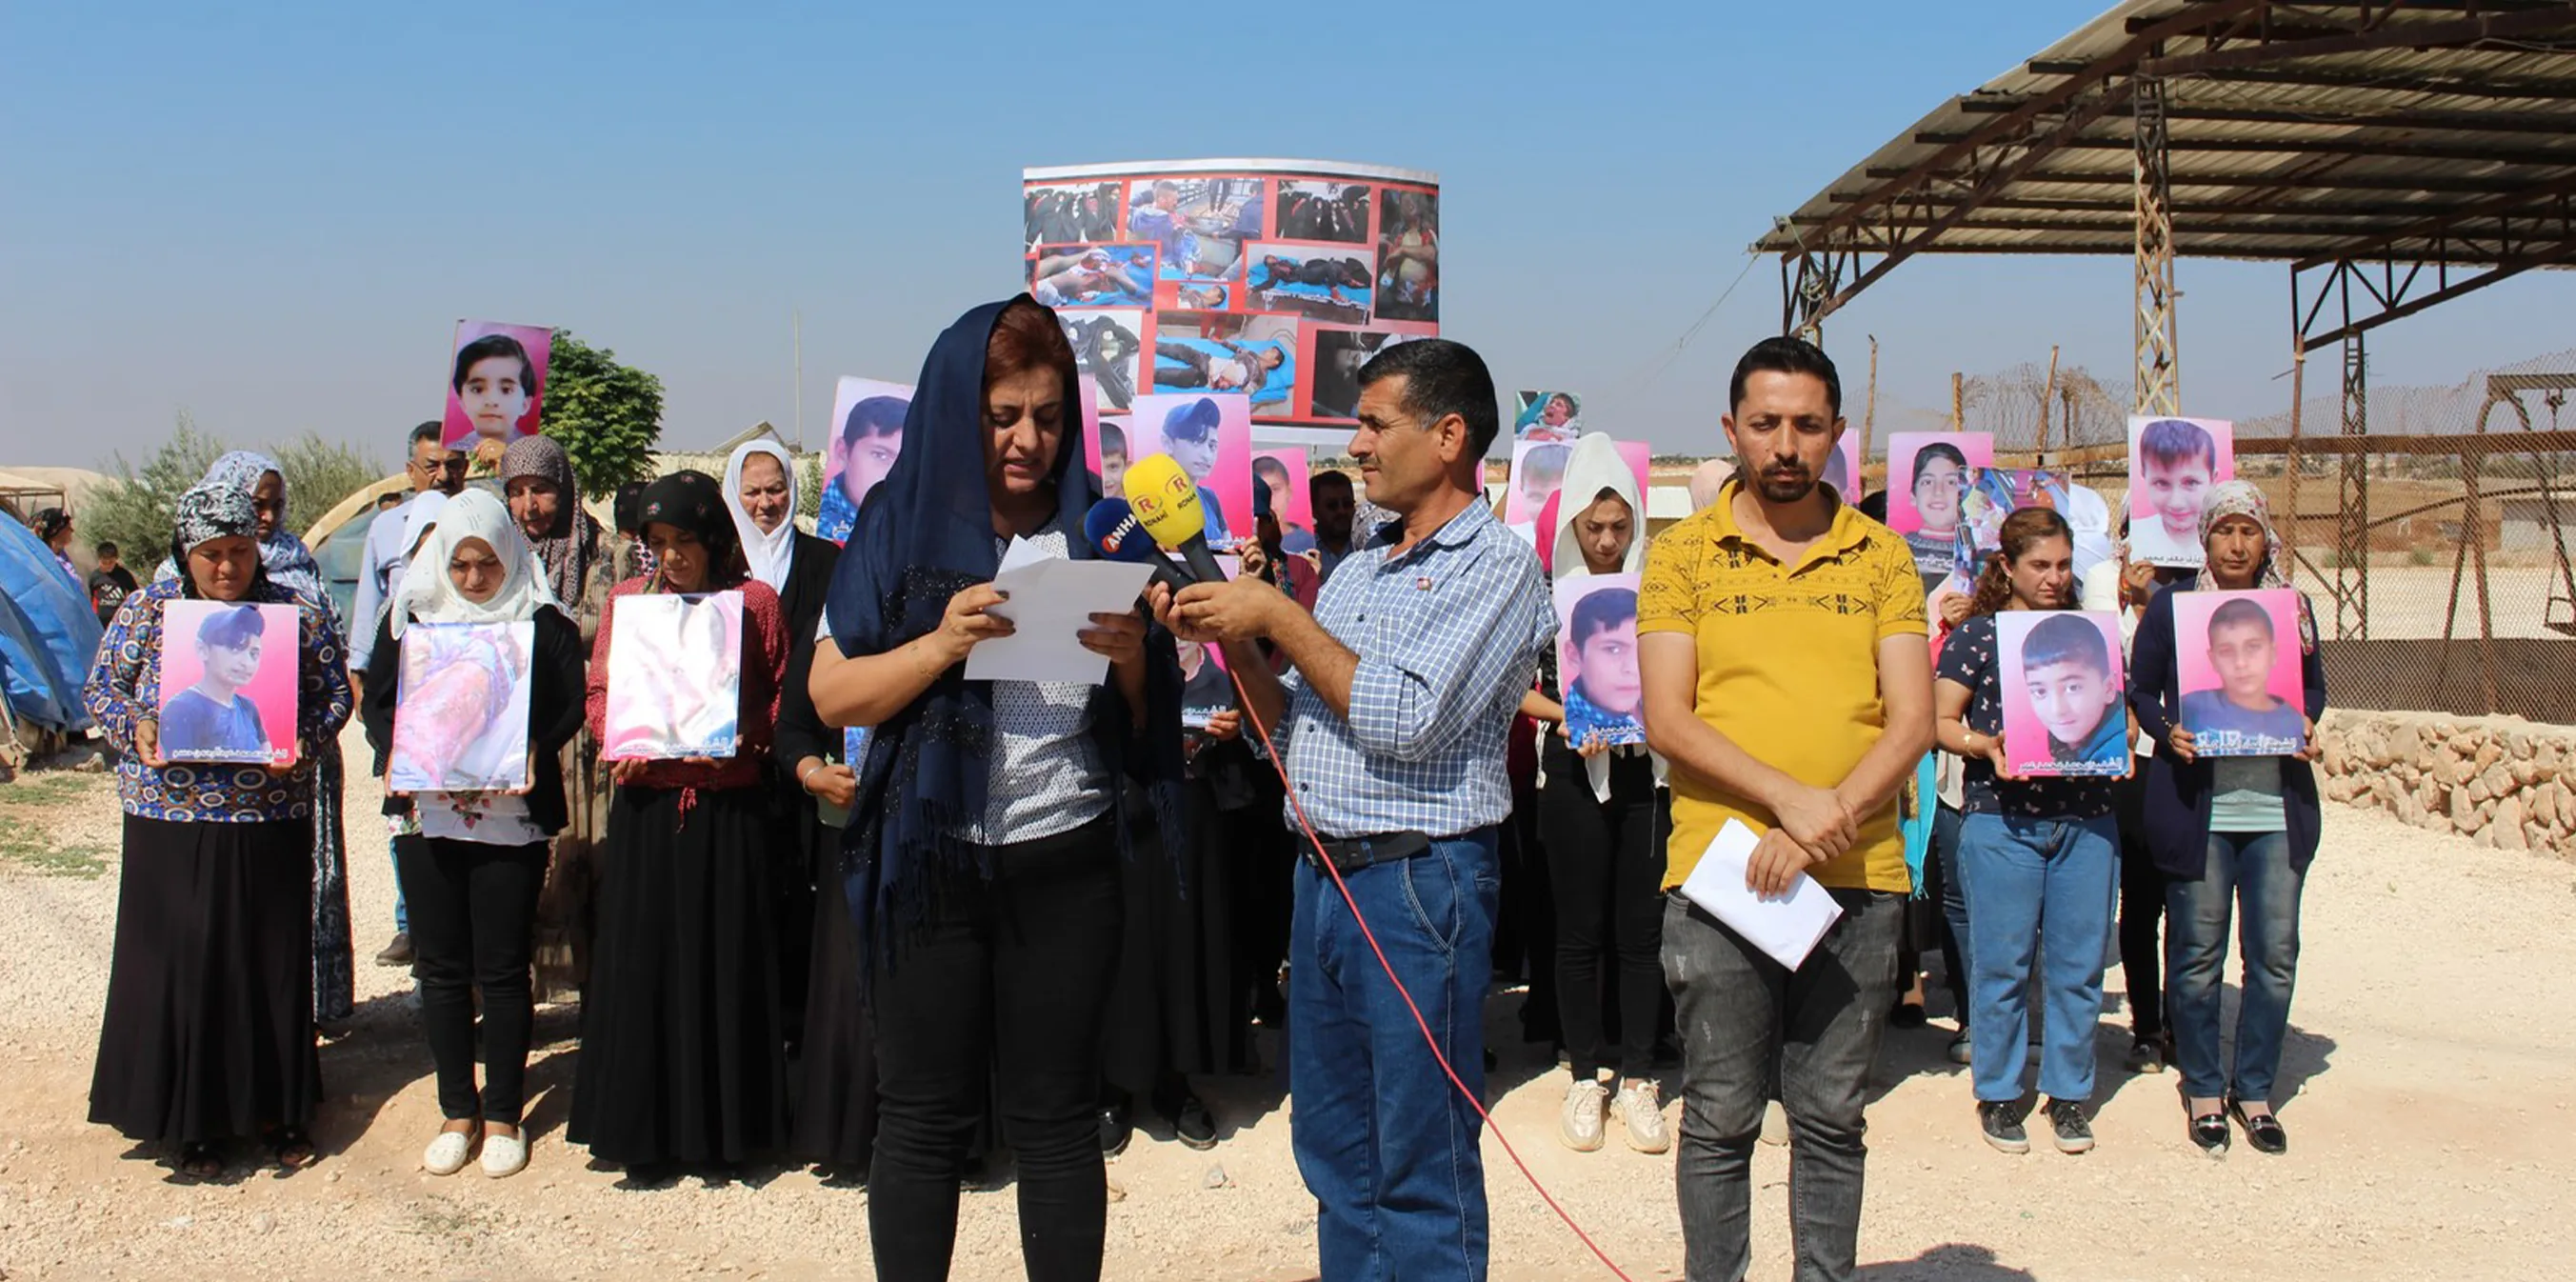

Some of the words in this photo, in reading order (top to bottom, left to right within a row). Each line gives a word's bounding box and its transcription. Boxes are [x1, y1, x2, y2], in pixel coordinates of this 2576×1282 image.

[1173, 476, 1188, 492] R
[1138, 497, 1155, 513] R
[1107, 512, 1138, 550] ANHA
